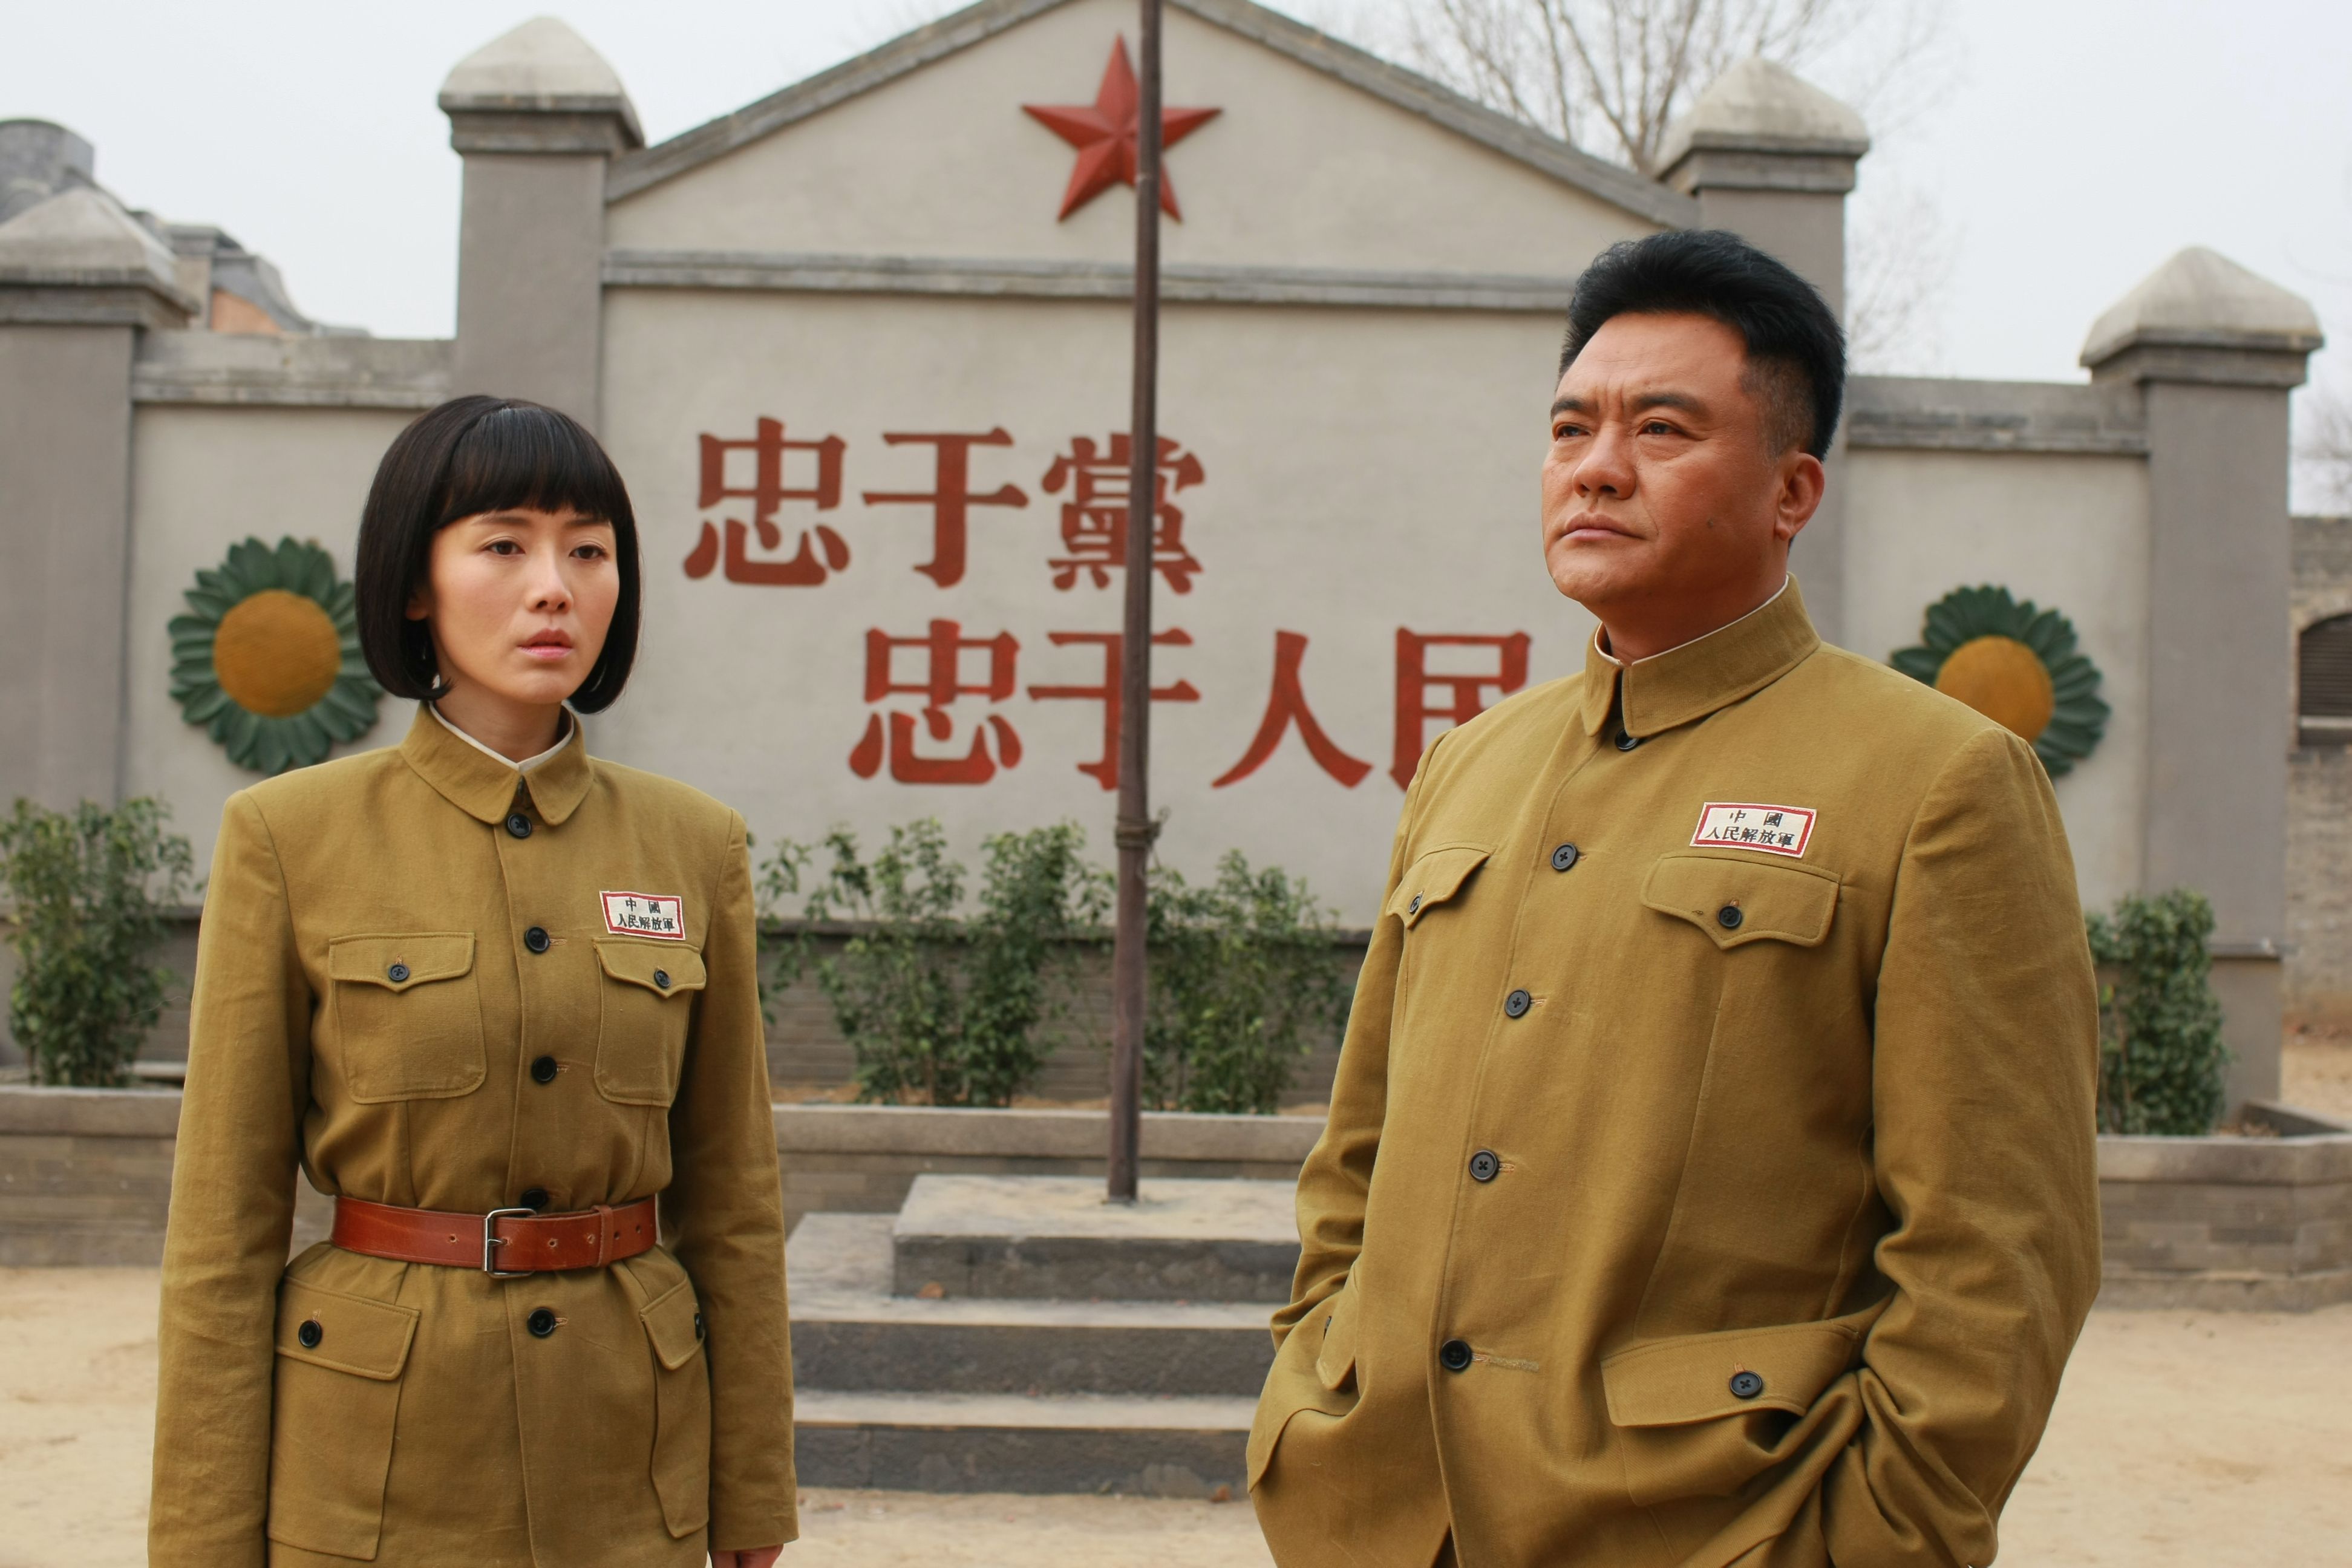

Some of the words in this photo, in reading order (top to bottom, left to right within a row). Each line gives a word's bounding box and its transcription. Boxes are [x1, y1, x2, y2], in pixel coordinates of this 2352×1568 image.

[683, 417, 1206, 594] 忠于黨
[1730, 809, 1783, 827] 中國
[1705, 826, 1795, 848] 人民解放軍
[626, 897, 661, 913] 中國
[618, 913, 675, 932] 人民解放軍
